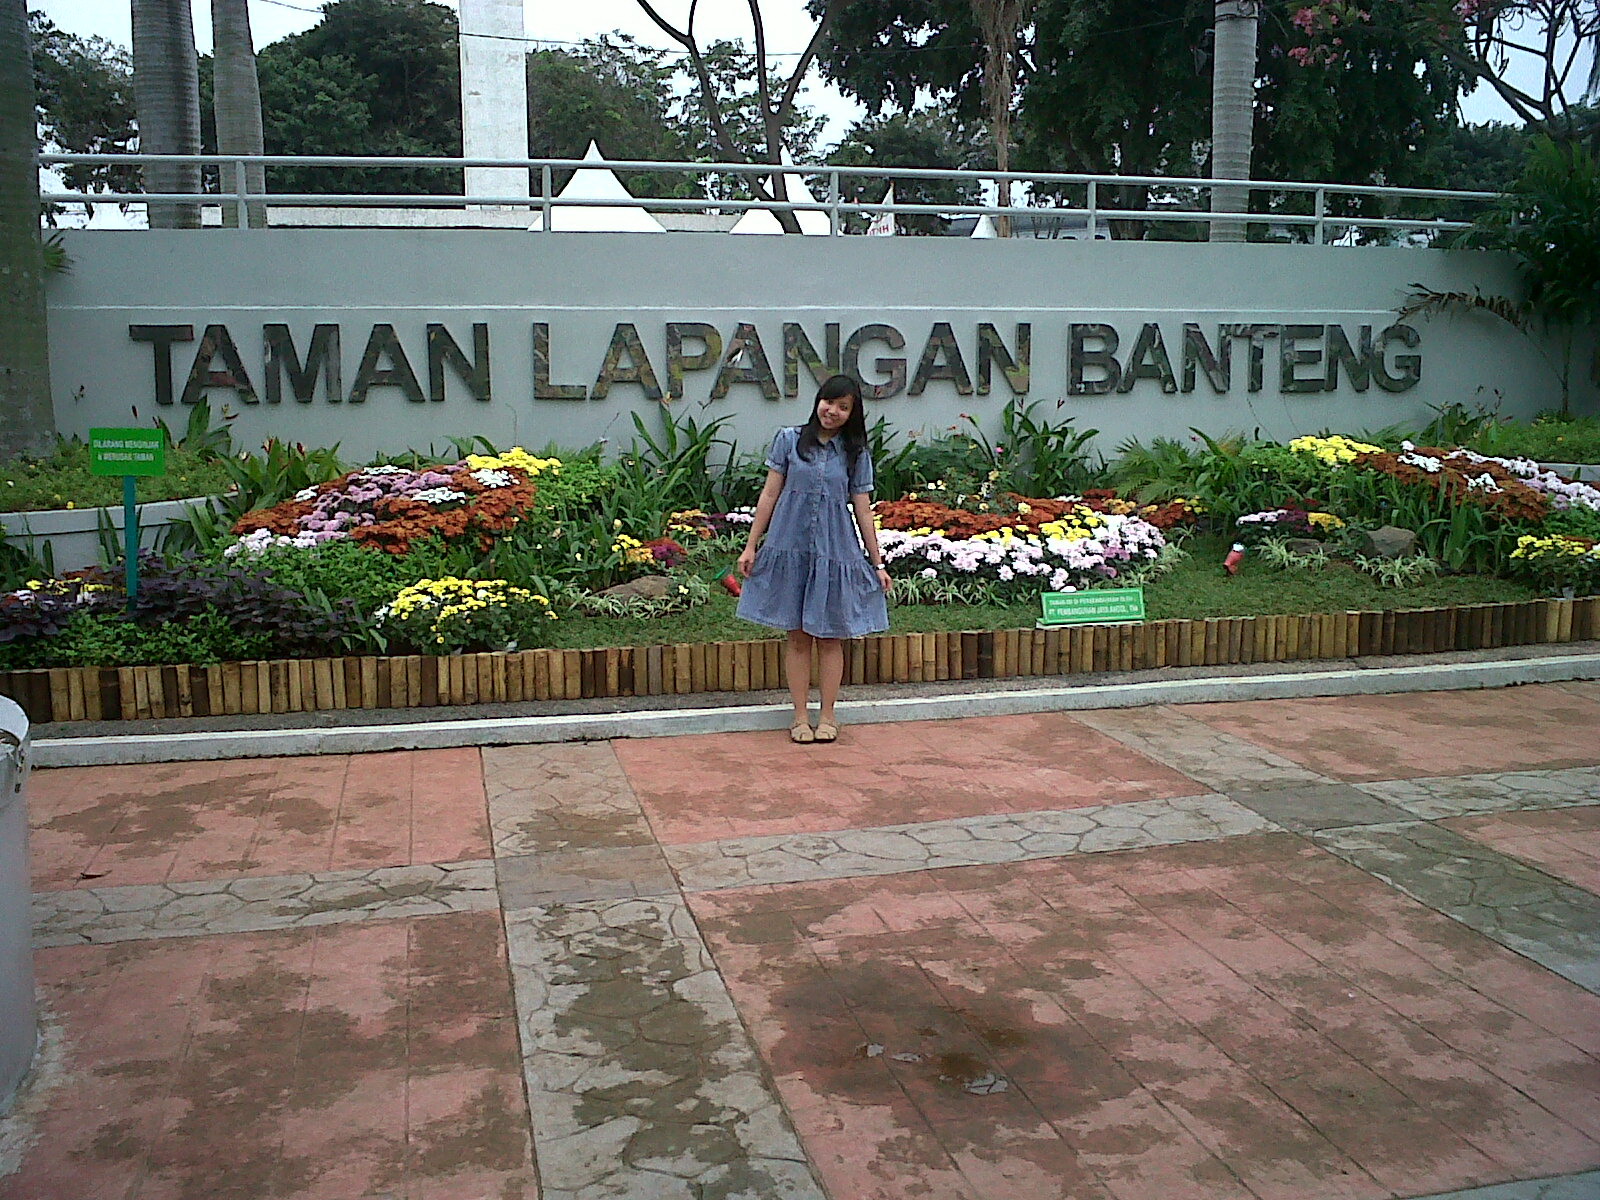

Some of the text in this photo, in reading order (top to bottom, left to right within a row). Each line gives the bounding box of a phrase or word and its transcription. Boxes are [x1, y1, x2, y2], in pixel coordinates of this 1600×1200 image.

[128, 322, 1422, 404] TAMAN LAPANGAN BANTENG
